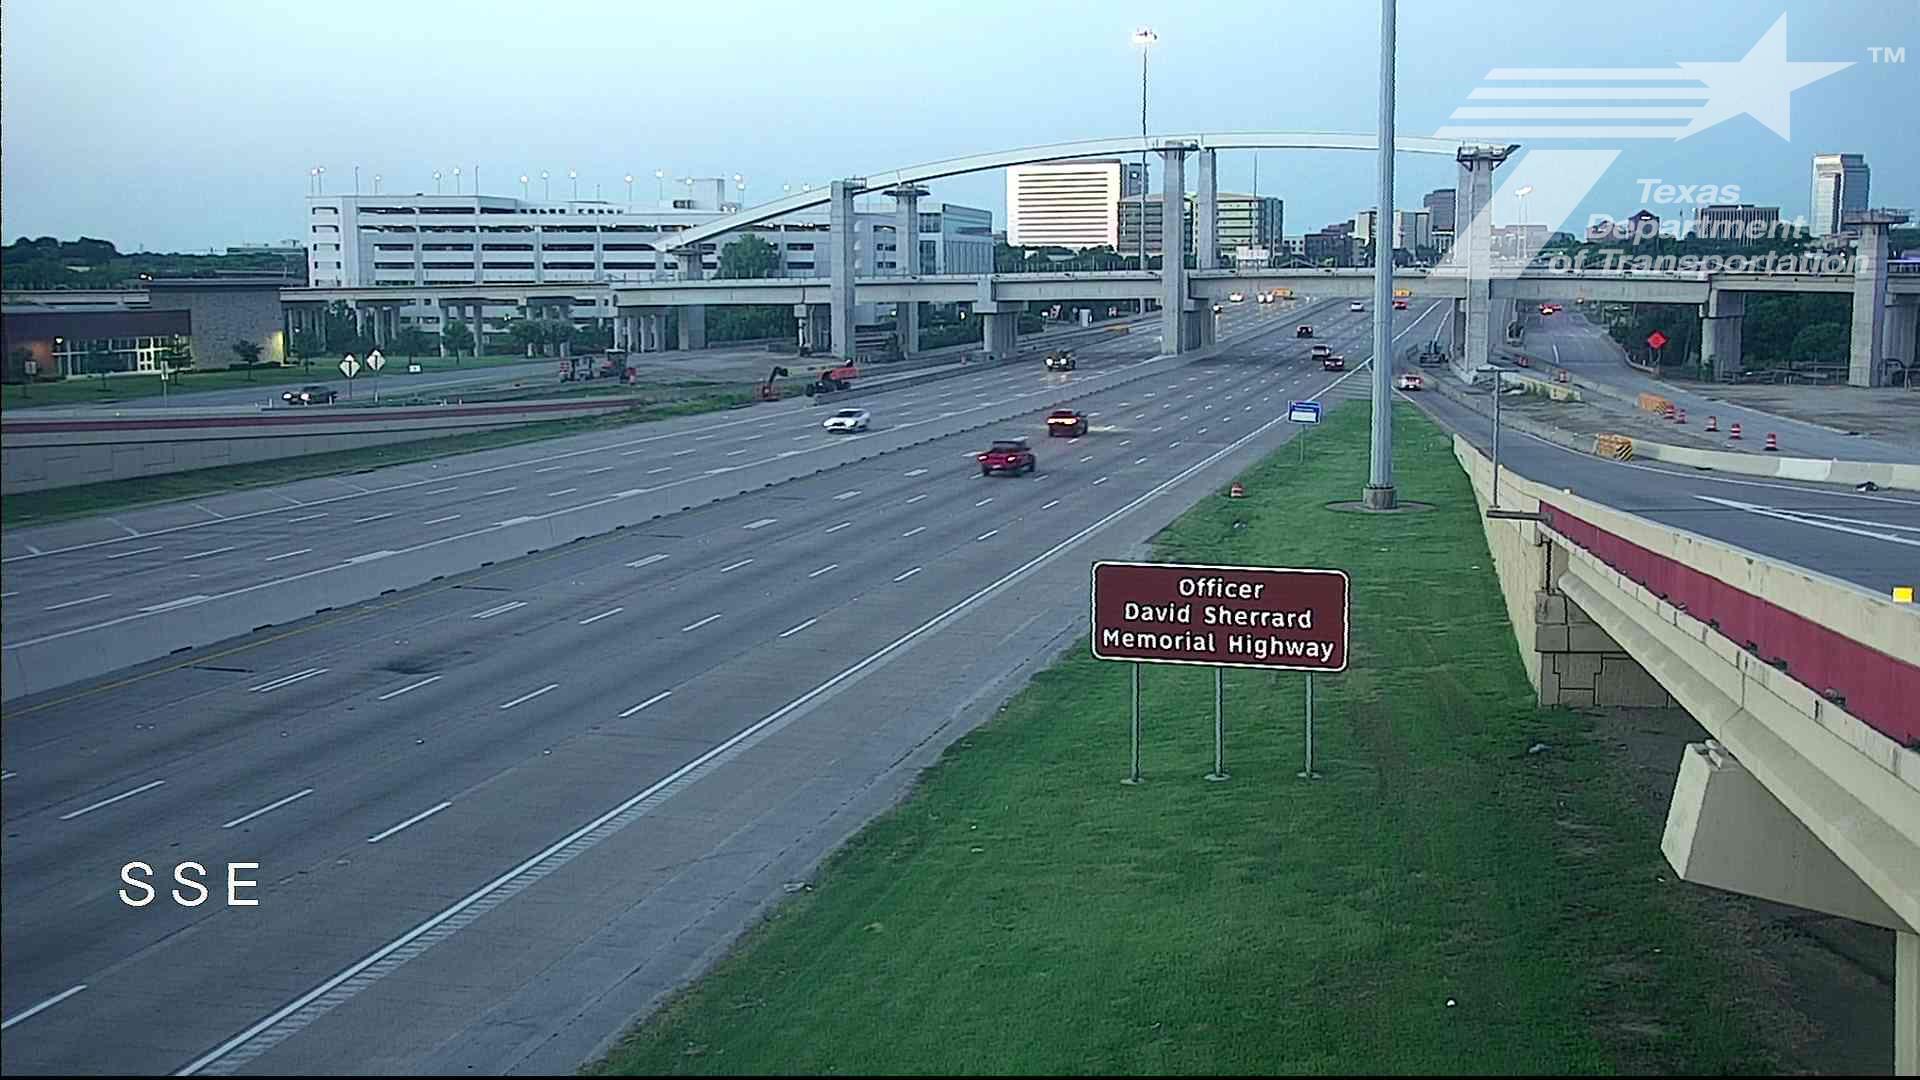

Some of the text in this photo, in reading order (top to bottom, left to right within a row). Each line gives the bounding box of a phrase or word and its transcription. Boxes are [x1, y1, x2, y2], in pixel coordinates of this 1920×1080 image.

[1179, 577, 1265, 599] Officer
[1125, 602, 1312, 629] David Sherrard
[1103, 629, 1334, 663] Memorial Highway
